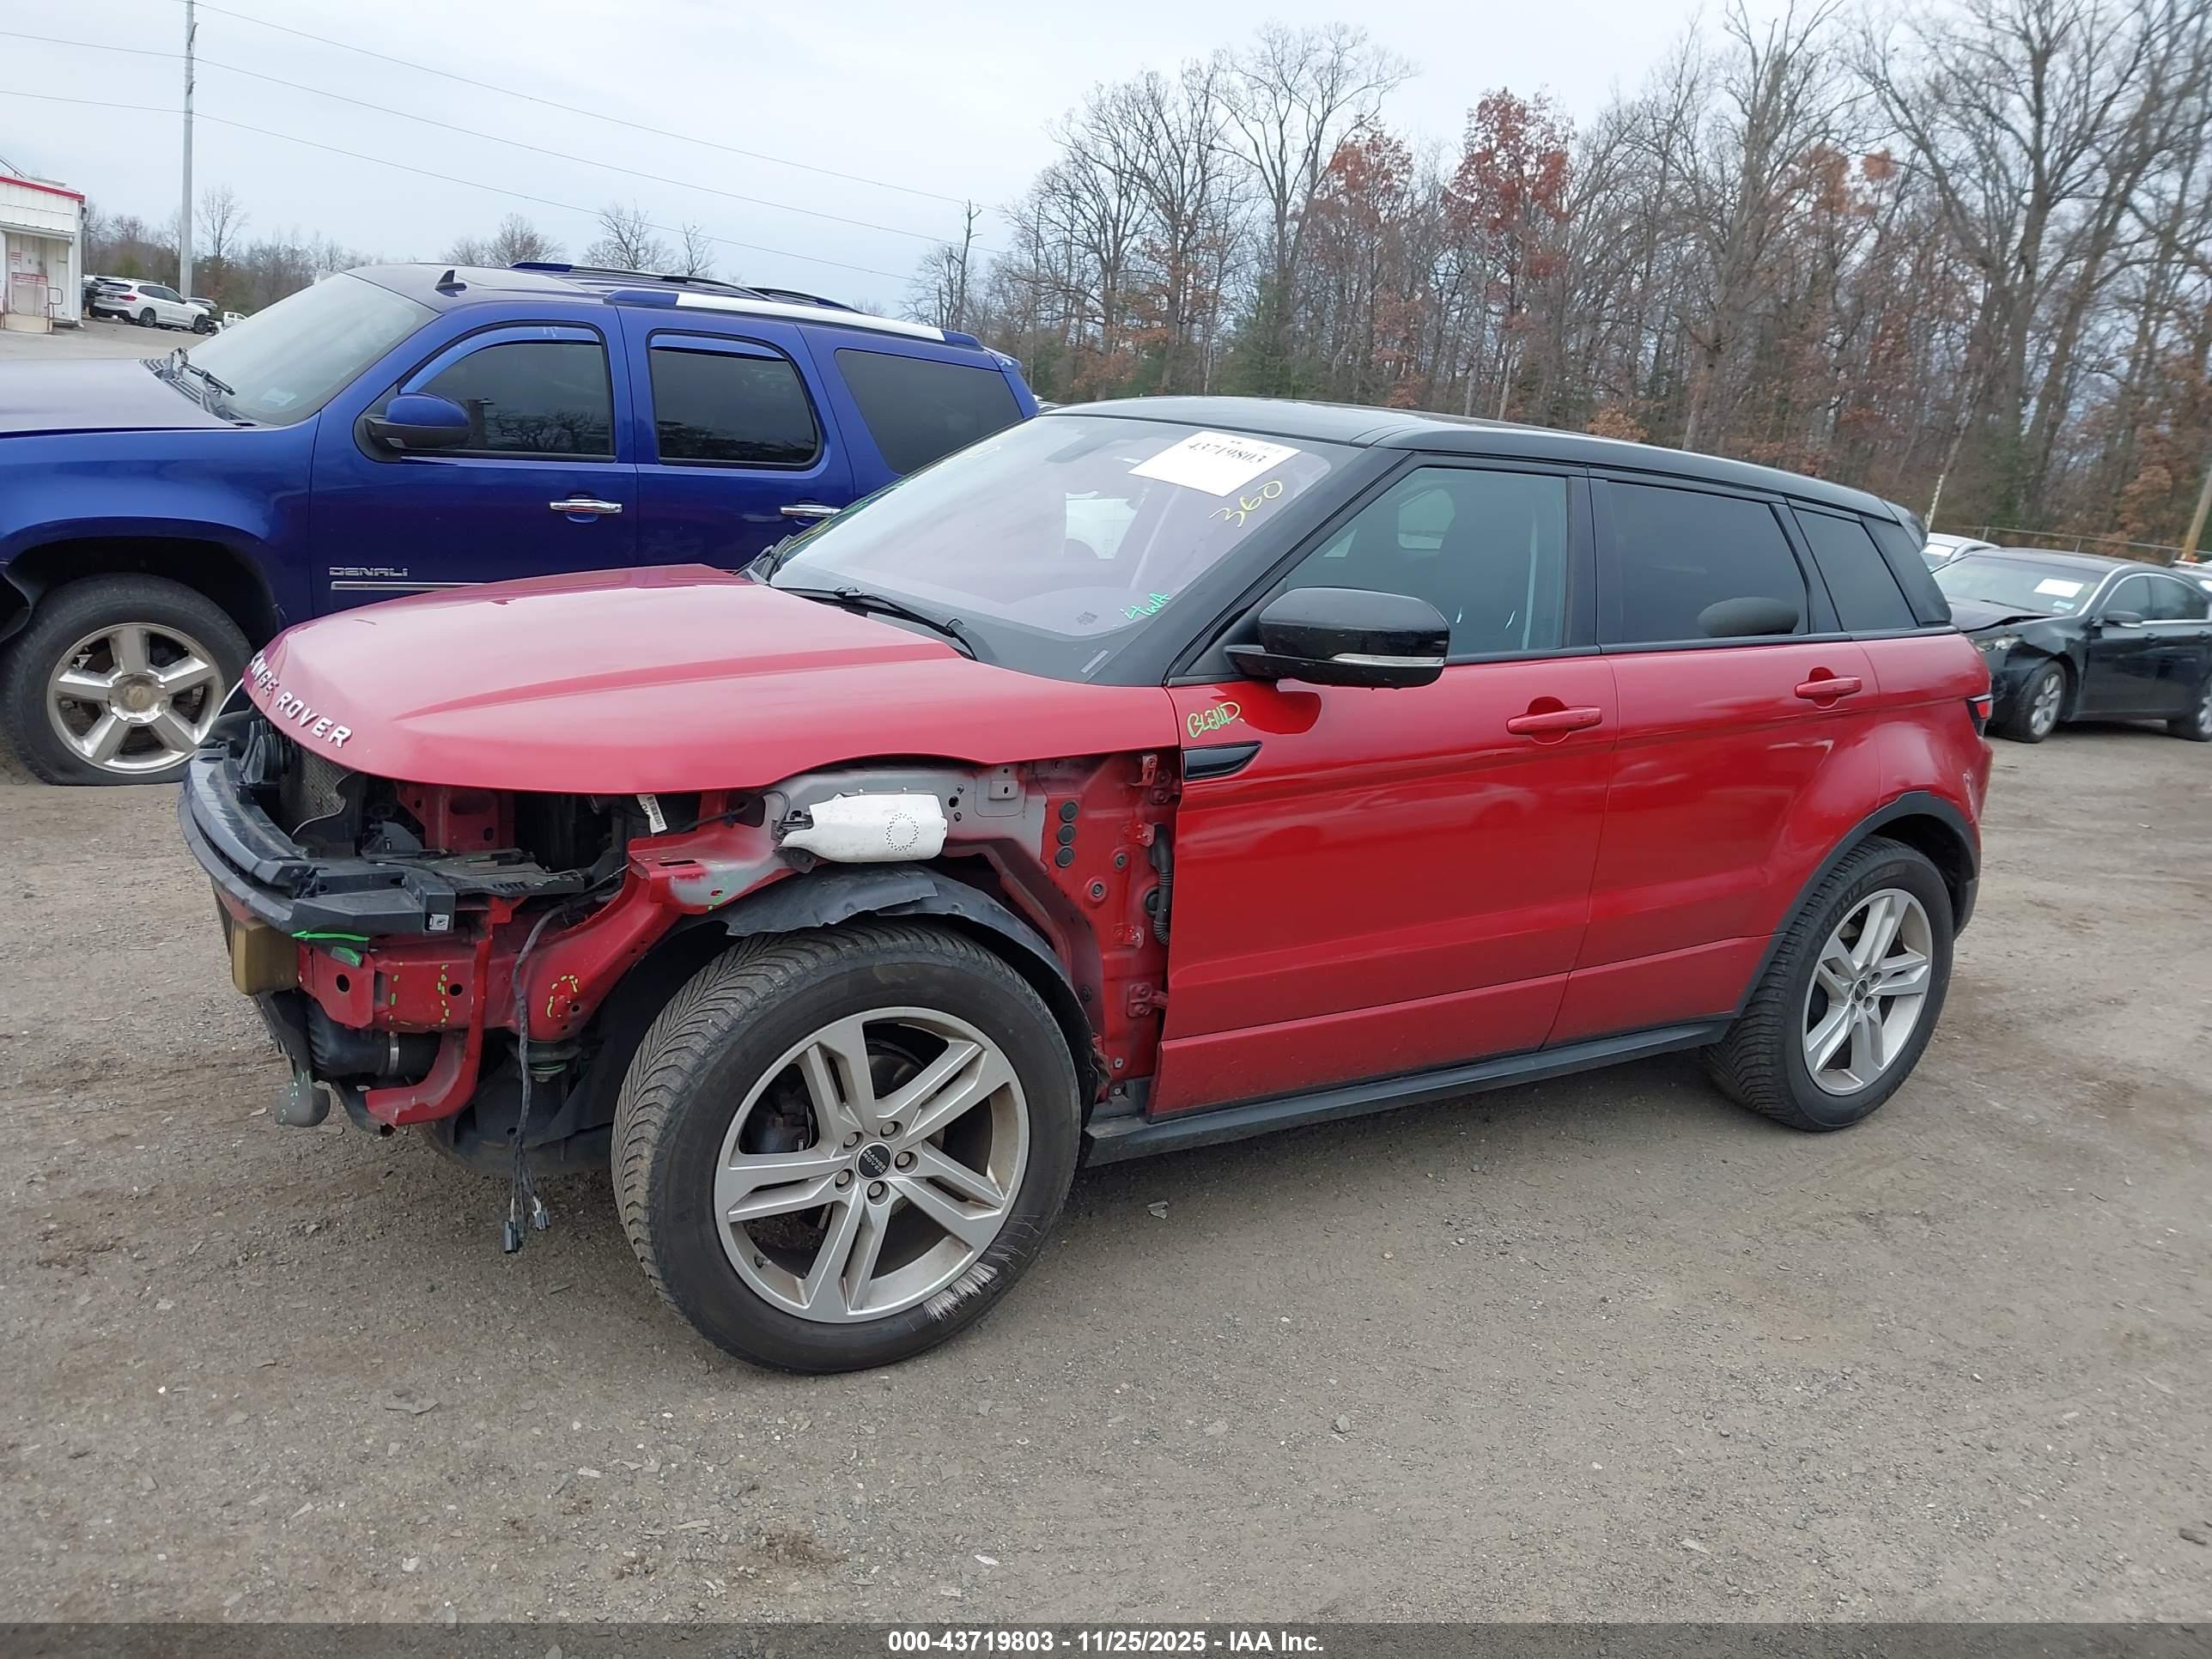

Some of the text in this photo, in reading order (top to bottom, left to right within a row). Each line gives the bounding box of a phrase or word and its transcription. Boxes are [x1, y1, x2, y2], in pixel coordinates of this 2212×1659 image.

[1188, 441, 1268, 465] 43719803
[1208, 480, 1284, 528] 360
[329, 567, 408, 577] DENALI
[276, 690, 353, 748] ROVER
[862, 1152, 884, 1174] ROVER
[866, 1149, 887, 1170] RANGE
